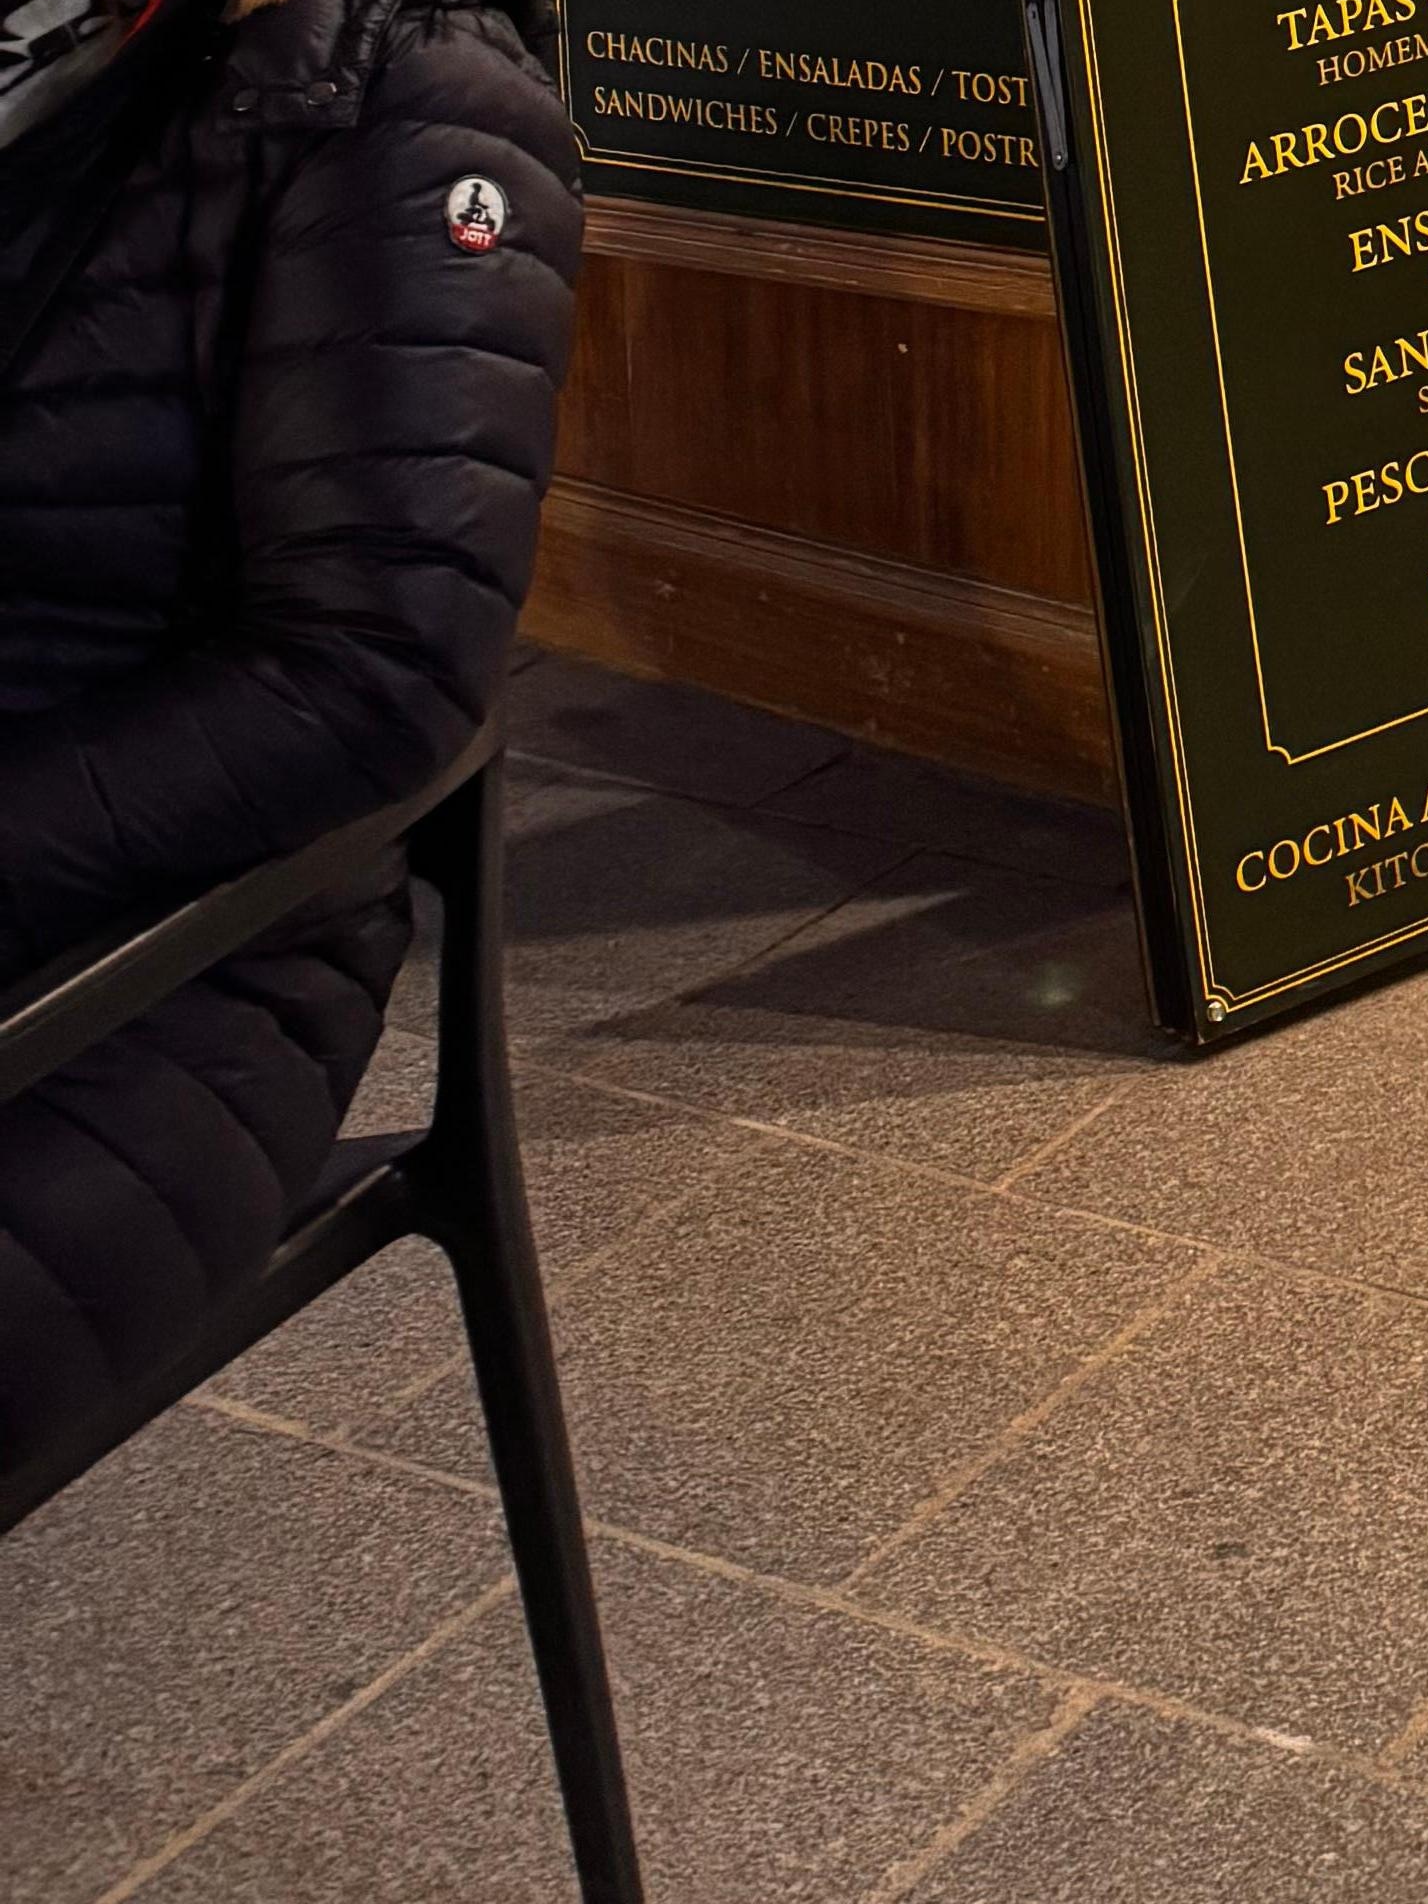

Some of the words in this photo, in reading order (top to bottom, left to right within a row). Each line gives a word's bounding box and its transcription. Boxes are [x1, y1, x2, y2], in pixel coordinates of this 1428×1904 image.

[587, 31, 727, 72] CHACINAS
[759, 50, 921, 94] ENSALADAS
[595, 87, 777, 134] SANDWICHES
[808, 114, 909, 151] CREPES
[1333, 156, 1405, 200] RICE
[1237, 797, 1413, 891] COCINA
